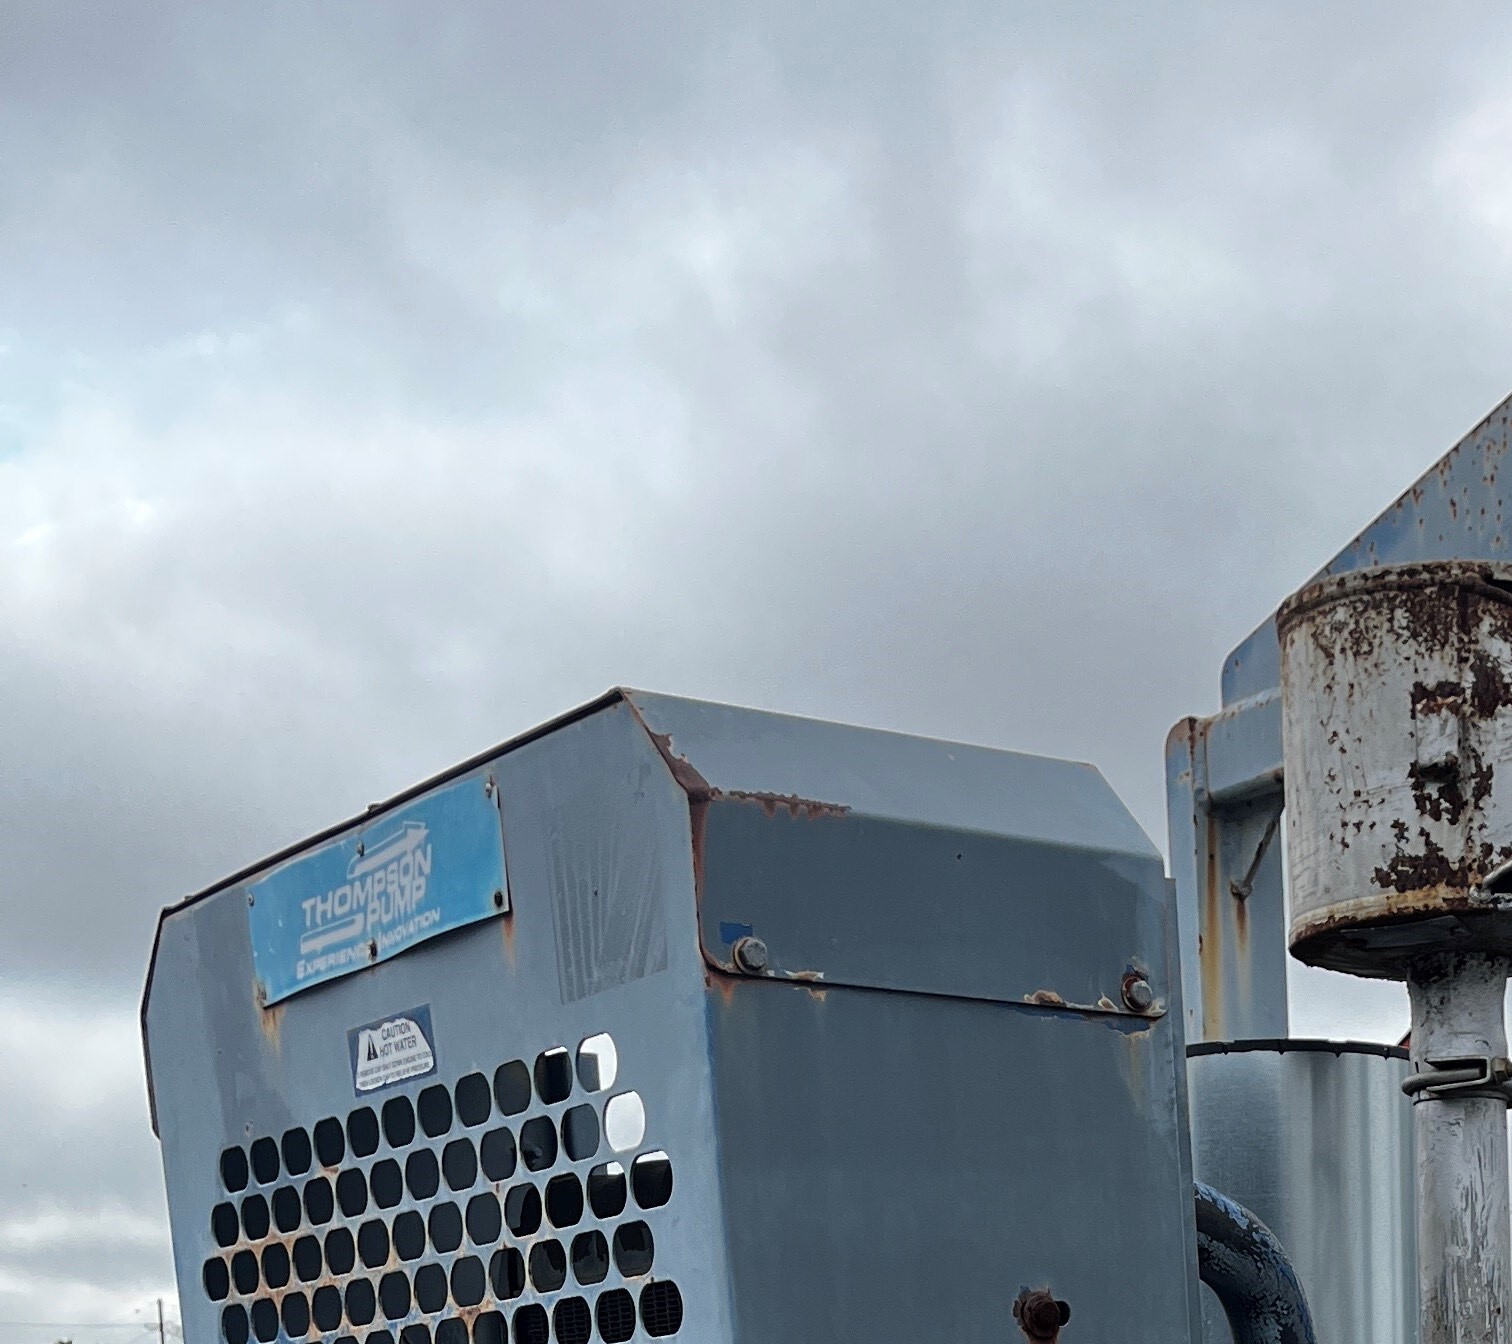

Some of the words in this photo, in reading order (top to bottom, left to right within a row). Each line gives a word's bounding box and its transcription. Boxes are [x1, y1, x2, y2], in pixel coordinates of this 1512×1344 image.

[302, 843, 432, 928] THOMPSON
[366, 876, 427, 937] PUMP
[379, 1042, 393, 1057] HOT
[394, 1035, 417, 1052] WATER
[382, 1021, 411, 1040] CAUTION
